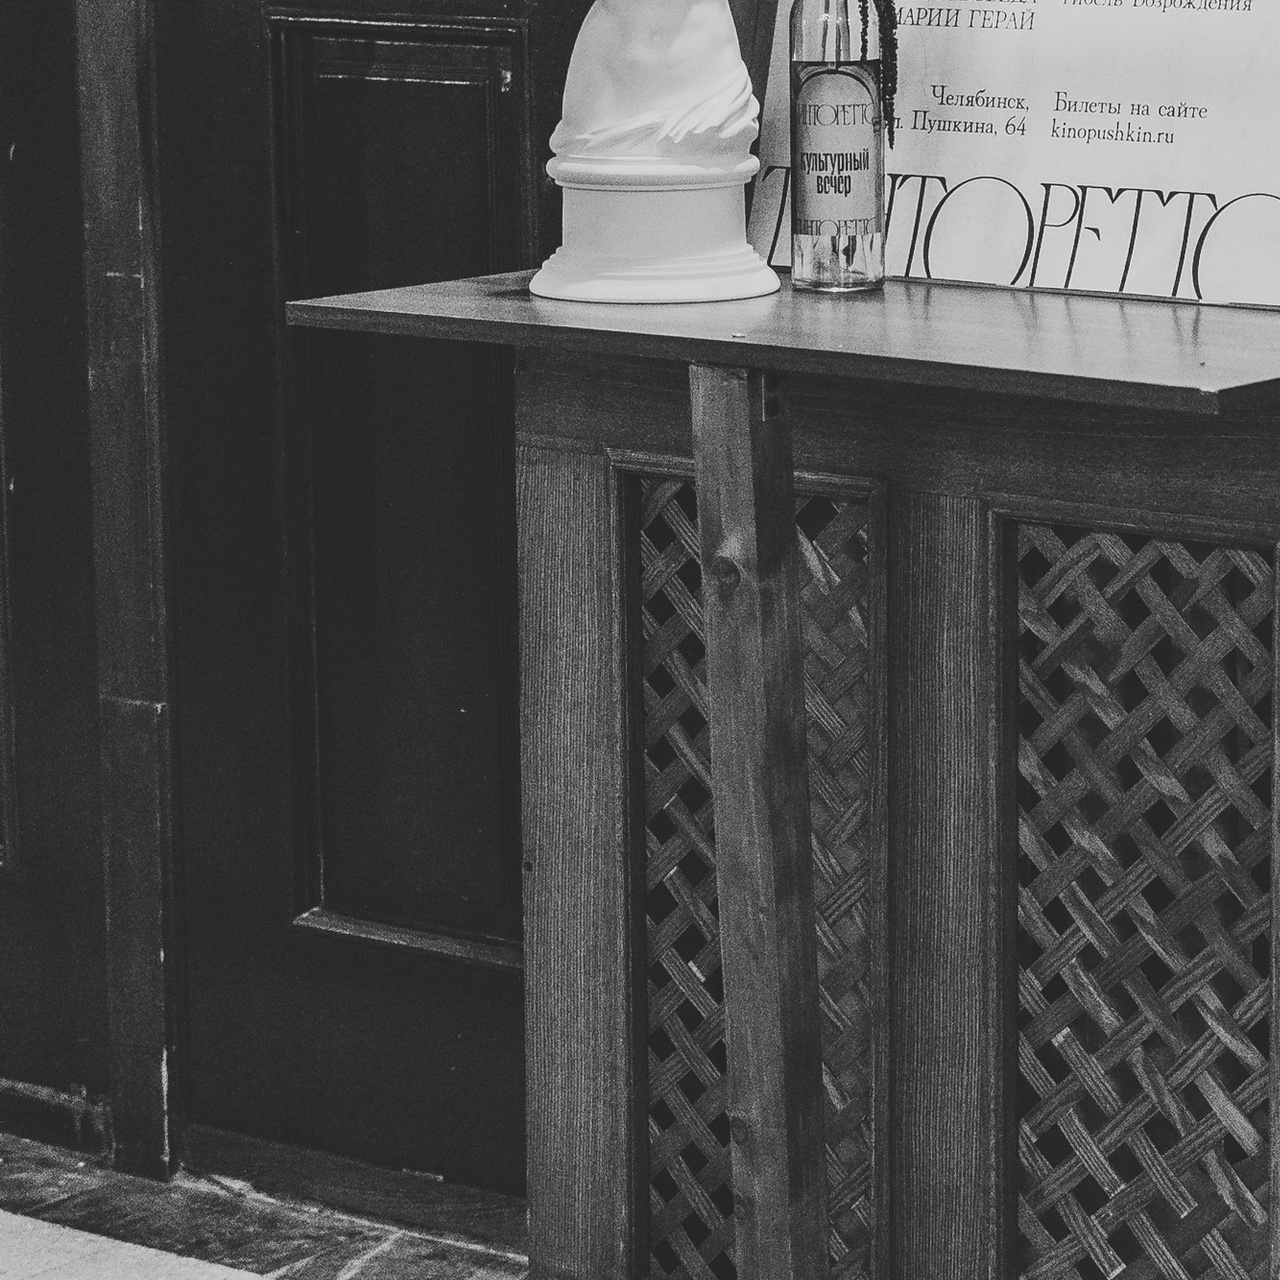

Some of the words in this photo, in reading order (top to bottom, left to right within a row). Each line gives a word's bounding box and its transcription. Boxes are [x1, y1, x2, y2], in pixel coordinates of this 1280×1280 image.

[966, 7, 1036, 31] ГЕРАЙ
[930, 84, 1030, 112] Челябинск,
[1052, 91, 1121, 114] Билеты
[1129, 101, 1150, 116] на
[1157, 99, 1208, 119] сайте
[911, 110, 998, 137] Пушкина,
[1004, 114, 1027, 136] 64
[1050, 118, 1175, 145] kinopushkin.ru
[816, 174, 852, 197] вечер
